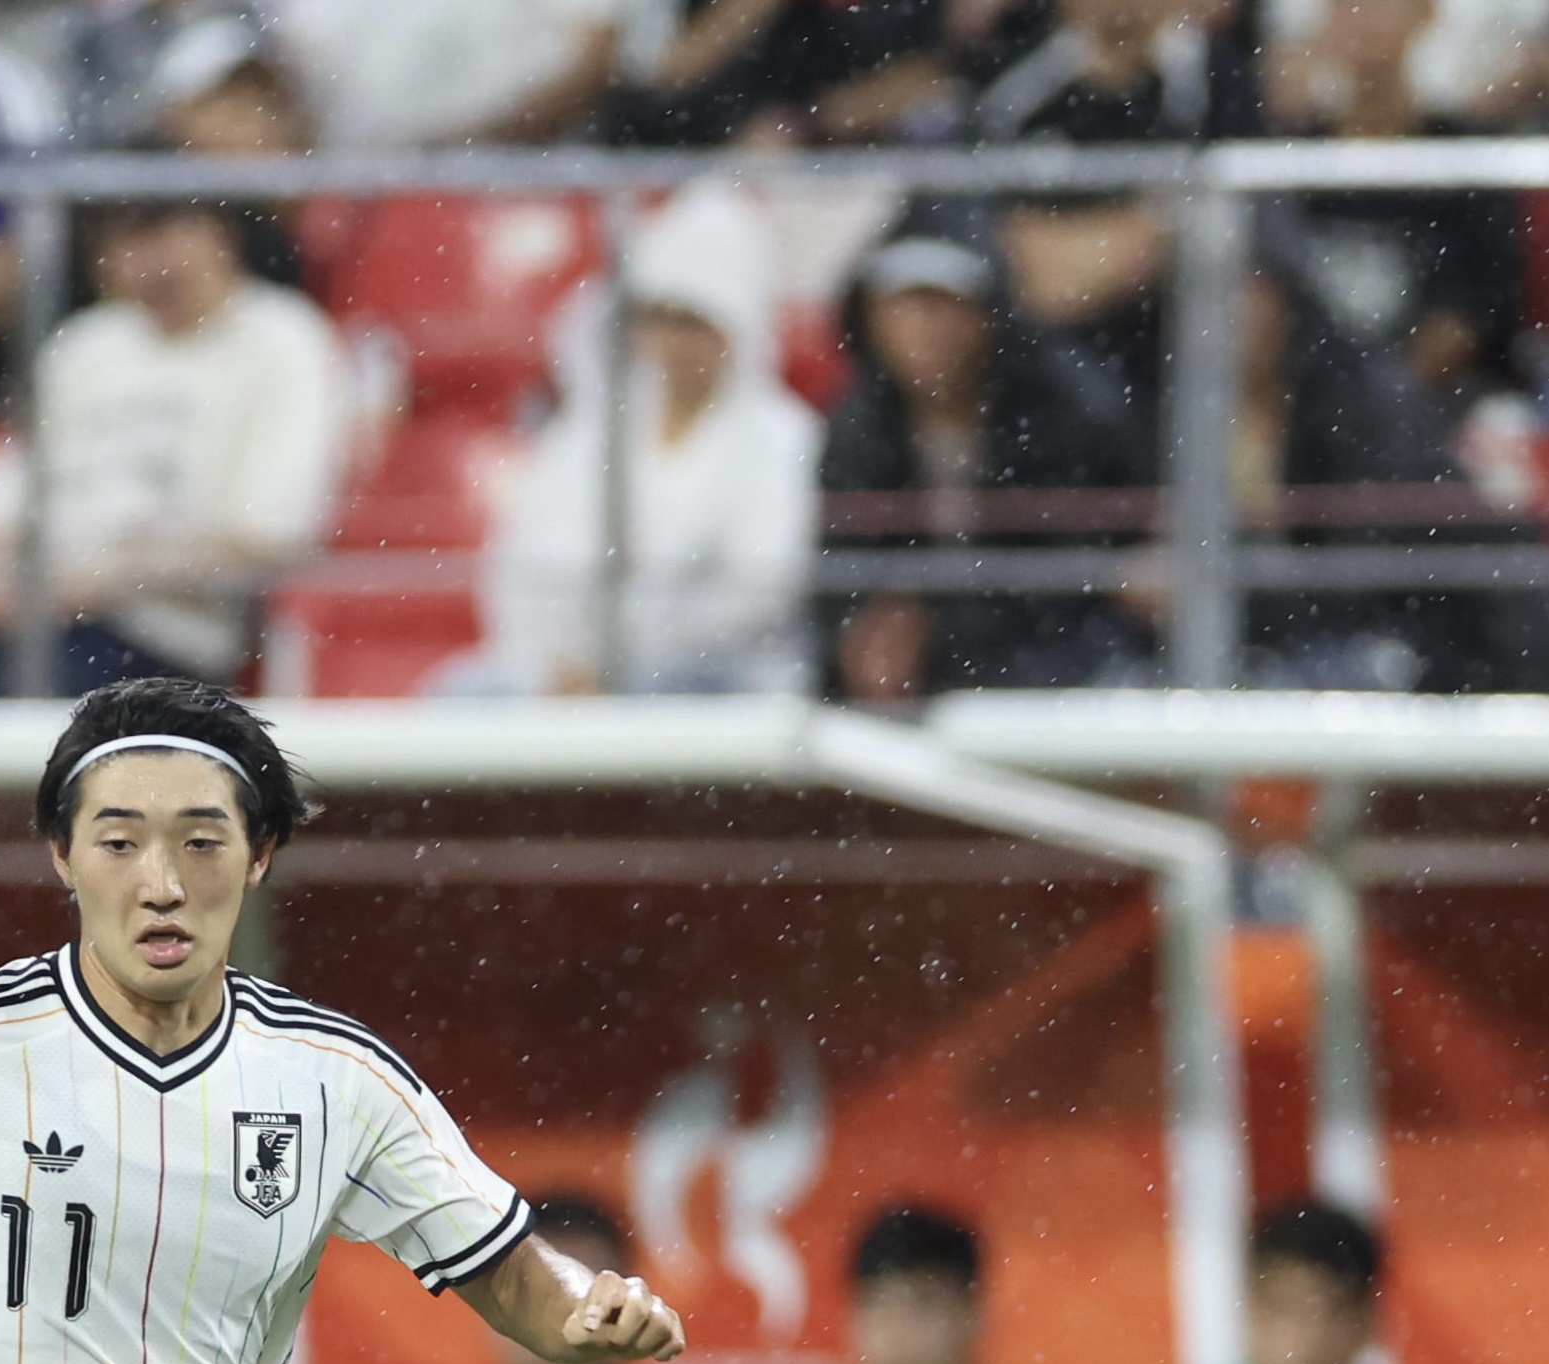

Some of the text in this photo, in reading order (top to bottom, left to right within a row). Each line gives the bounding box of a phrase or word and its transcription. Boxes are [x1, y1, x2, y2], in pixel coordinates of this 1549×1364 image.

[249, 1113, 287, 1125] JAPAN
[252, 1184, 283, 1202] JFA
[0, 1193, 98, 1322] 11
